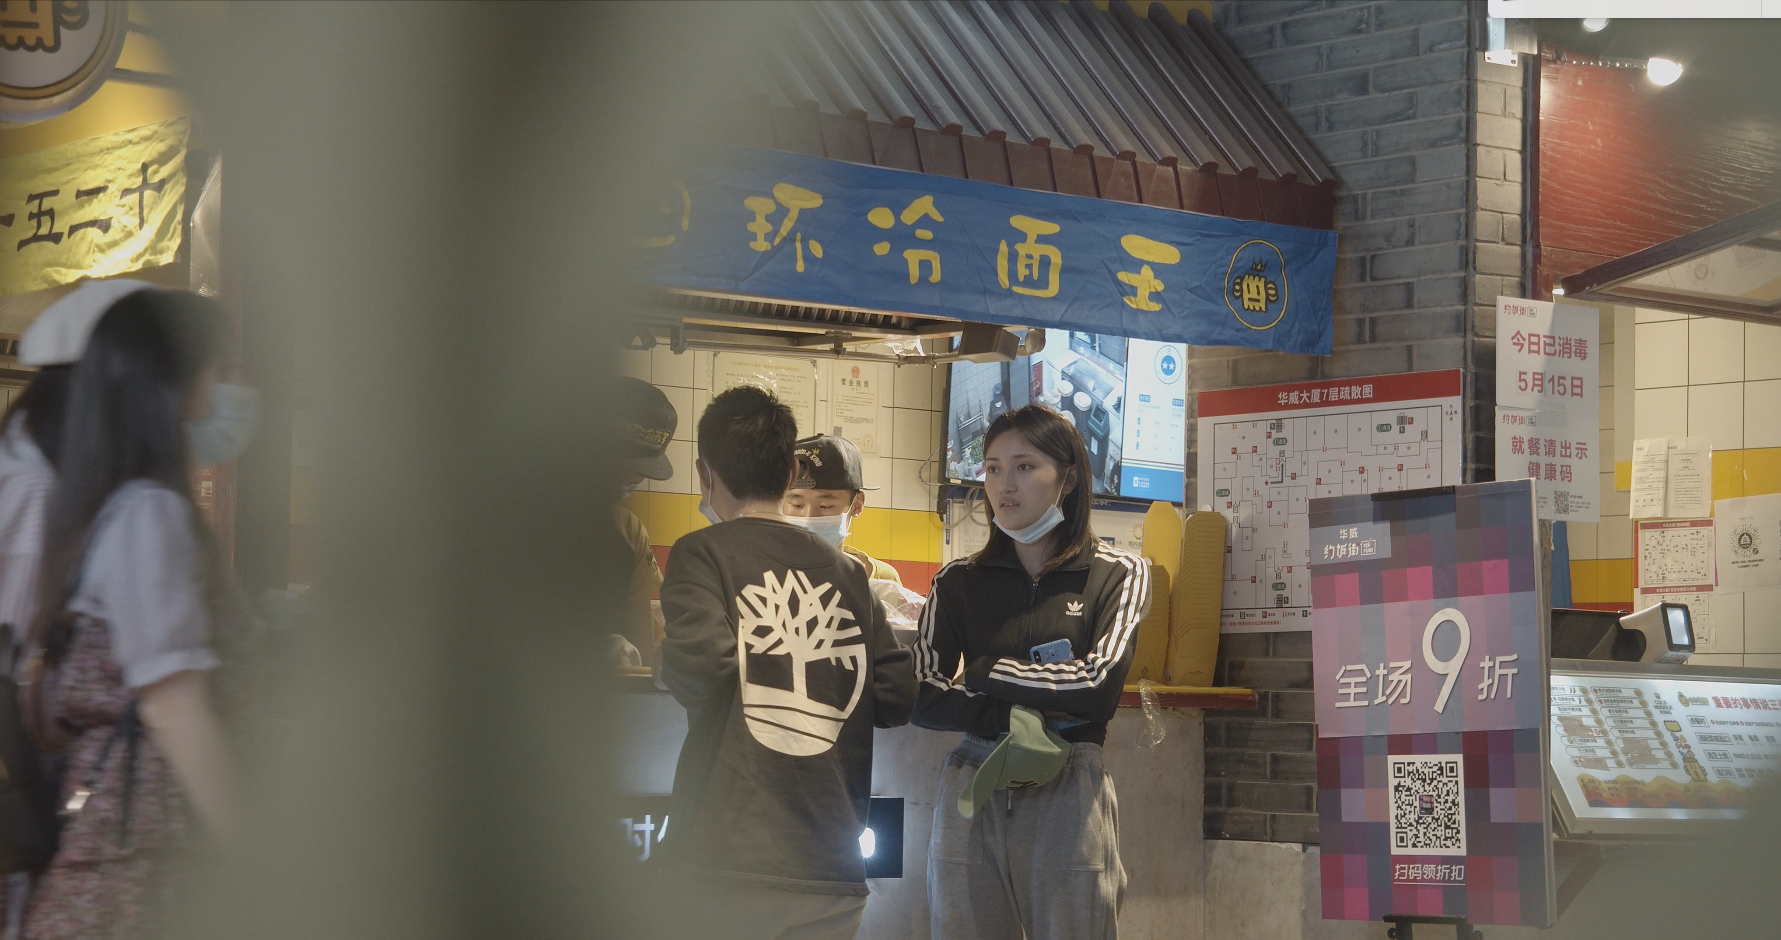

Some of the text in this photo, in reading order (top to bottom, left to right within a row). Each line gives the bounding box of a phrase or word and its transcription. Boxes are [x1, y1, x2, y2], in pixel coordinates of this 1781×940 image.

[1511, 330, 1588, 361] 今日已消毒
[840, 377, 870, 389] 营业执照
[1518, 370, 1584, 399] 5月15日
[1277, 384, 1373, 406] 华威大厦7层疏散图
[1511, 435, 1588, 460] 就餐请出示
[1527, 461, 1573, 483] 健康码
[1339, 527, 1359, 540] 华威
[1393, 862, 1465, 882] 扫码领折扣
